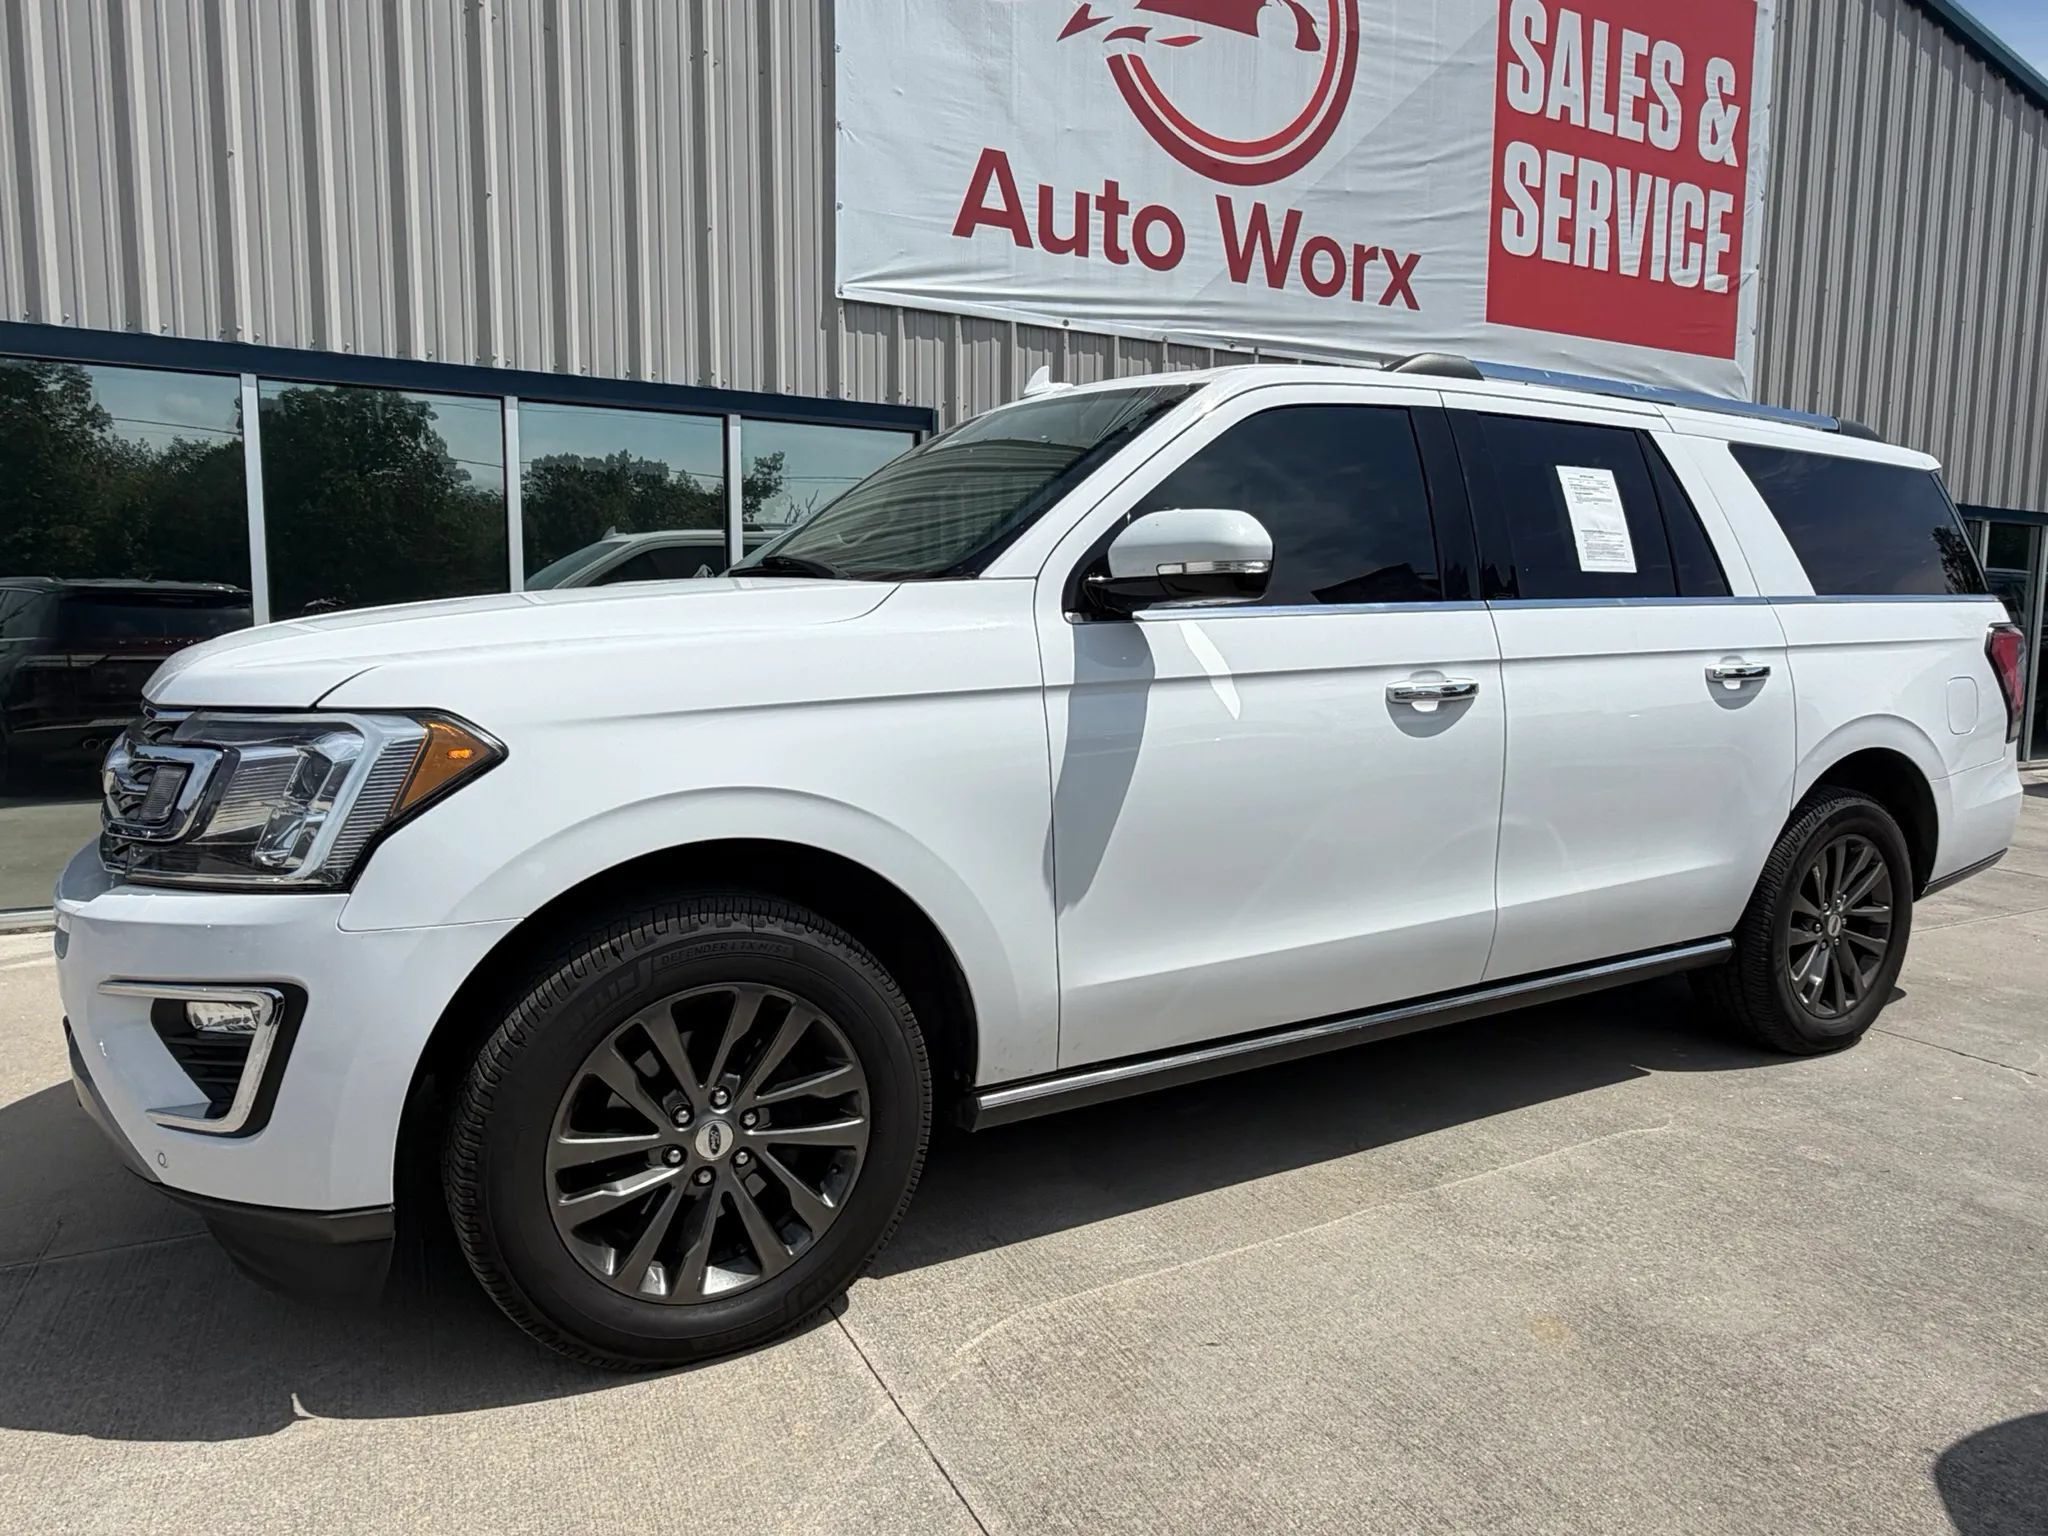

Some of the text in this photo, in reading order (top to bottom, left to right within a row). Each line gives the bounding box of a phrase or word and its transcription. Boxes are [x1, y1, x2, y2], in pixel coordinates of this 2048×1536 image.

[1507, 0, 1741, 167] SALES &
[952, 147, 1422, 312] Auto Worx
[1501, 141, 1734, 293] SERVICE
[661, 942, 728, 966] DEFENDER
